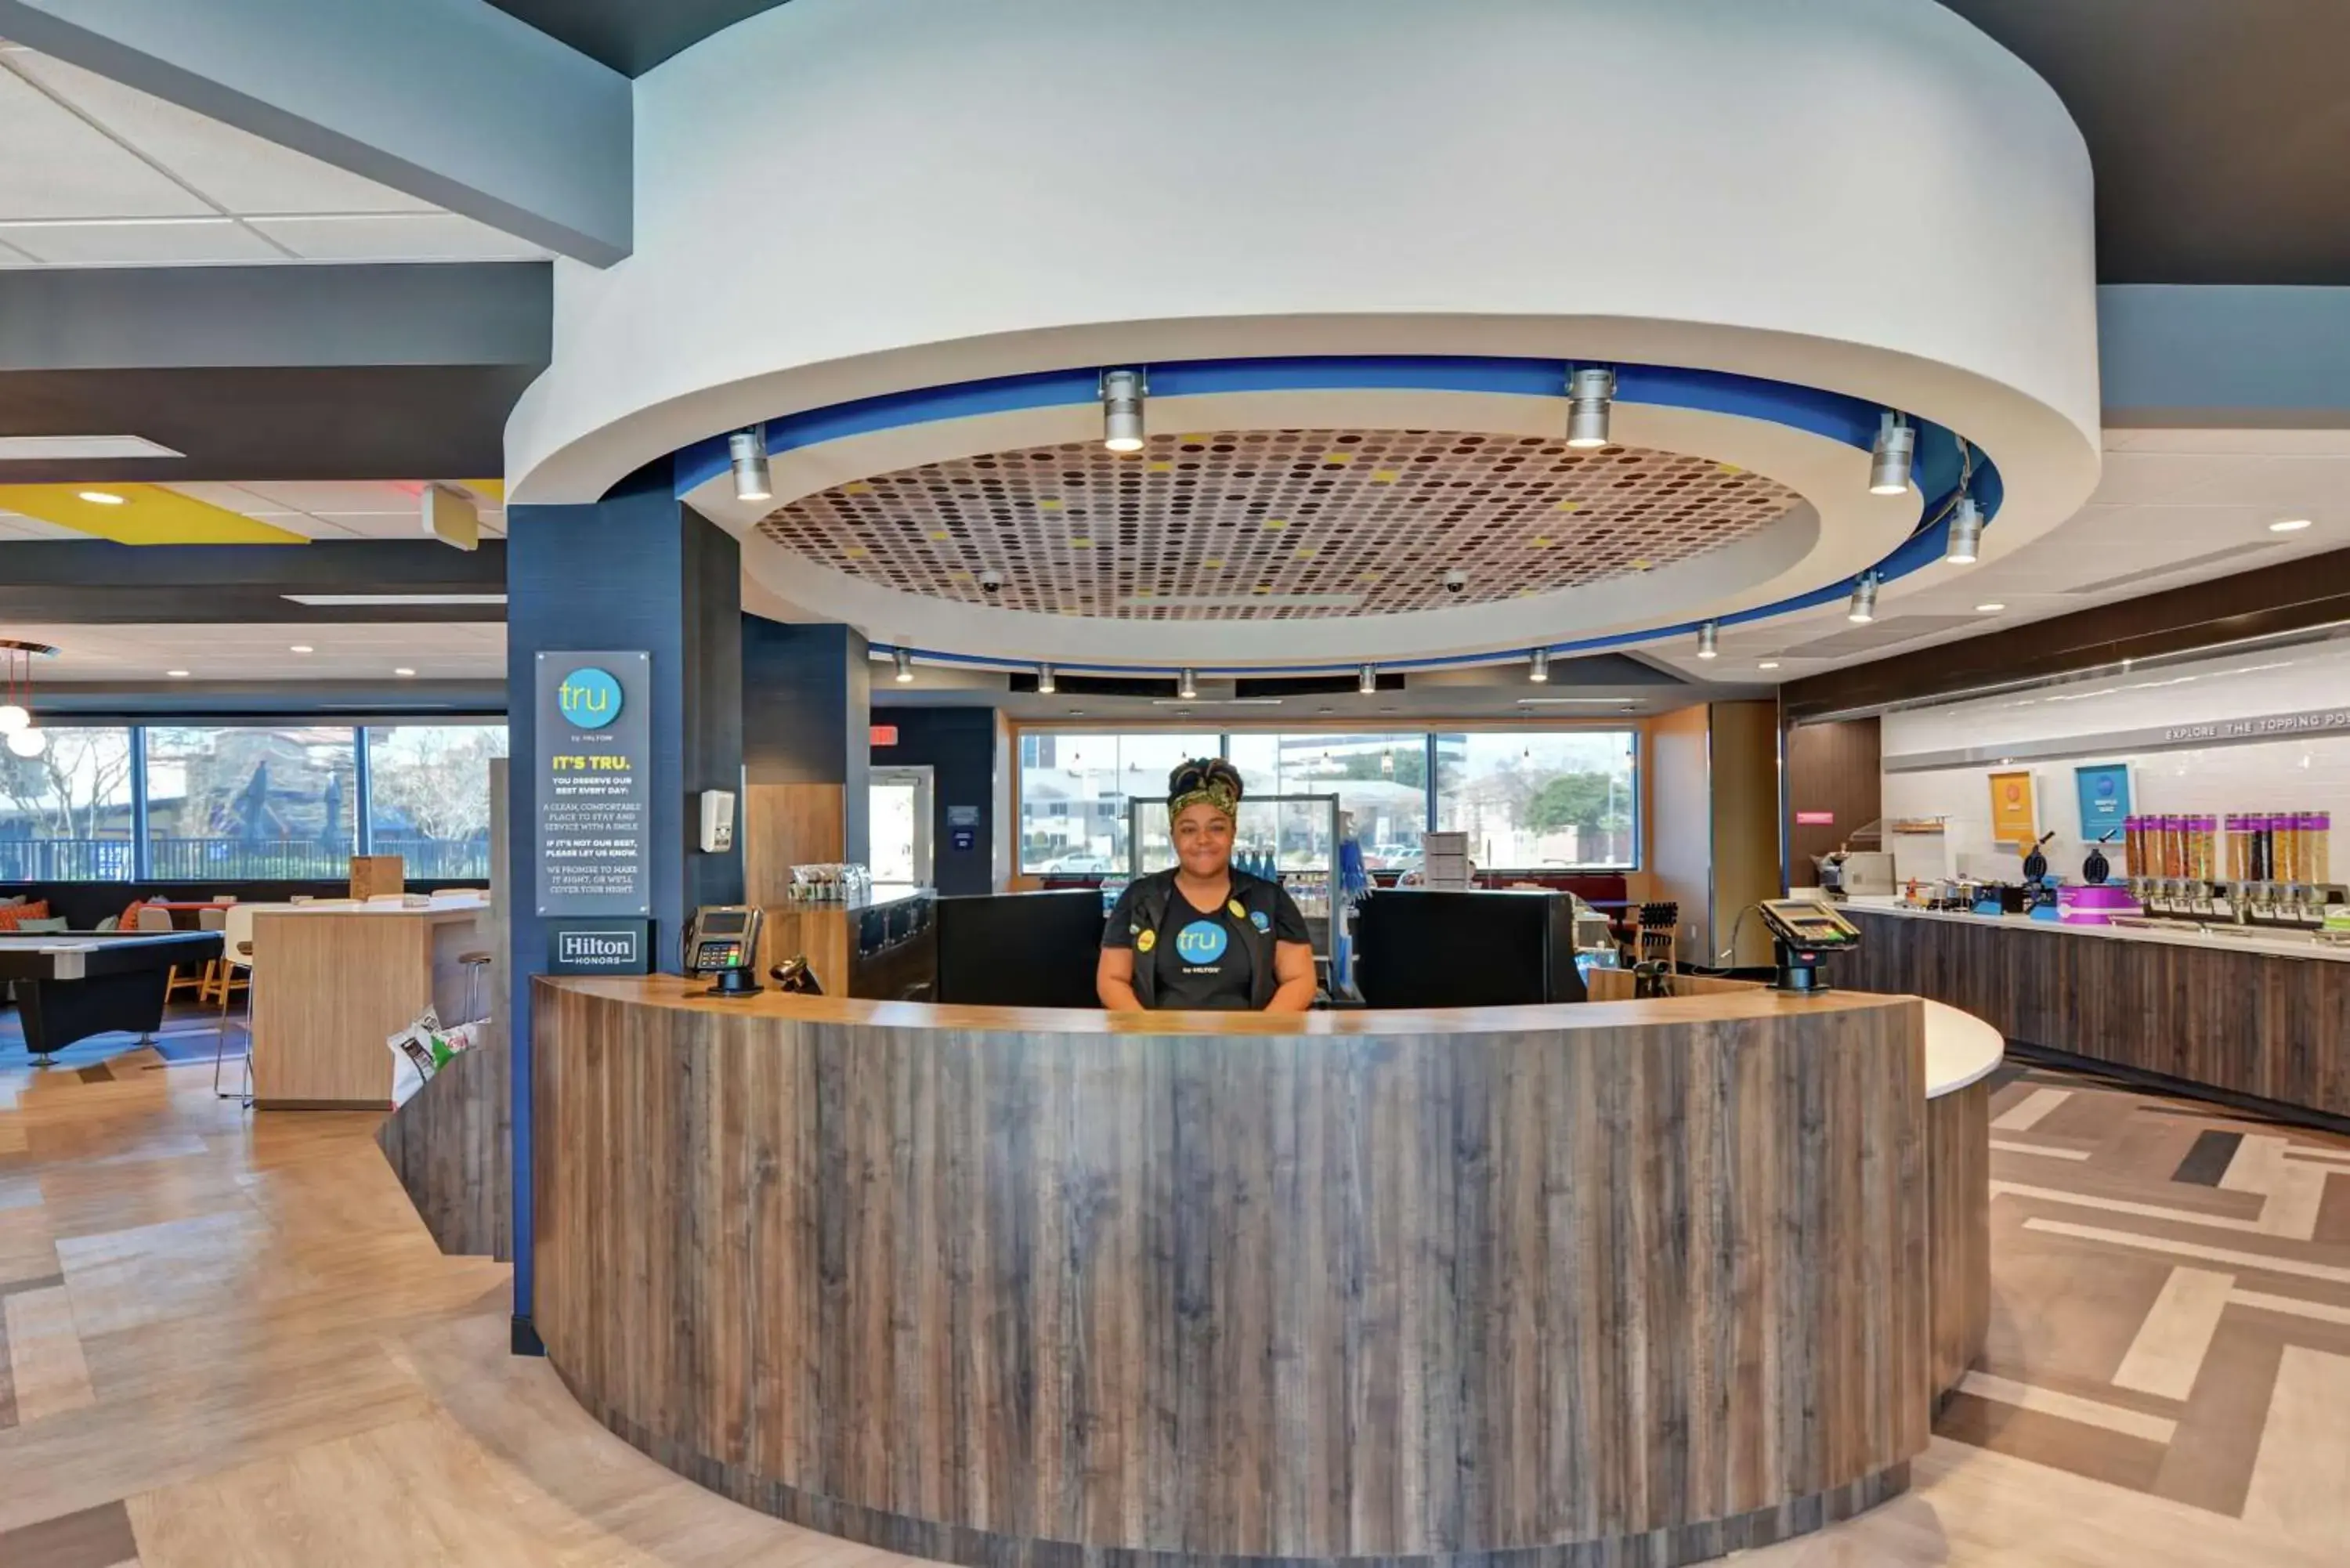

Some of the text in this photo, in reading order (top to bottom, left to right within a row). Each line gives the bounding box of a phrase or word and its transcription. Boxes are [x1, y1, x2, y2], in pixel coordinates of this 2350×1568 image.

[559, 681, 606, 711] tru
[2165, 726, 2217, 740] EXPLORE
[2226, 721, 2254, 734] THE
[2260, 714, 2321, 731] TOPPING
[552, 755, 631, 771] IT'S TRU.
[566, 938, 630, 955] Hilton
[1178, 930, 1215, 950] tru
[575, 956, 620, 965] HONORS
